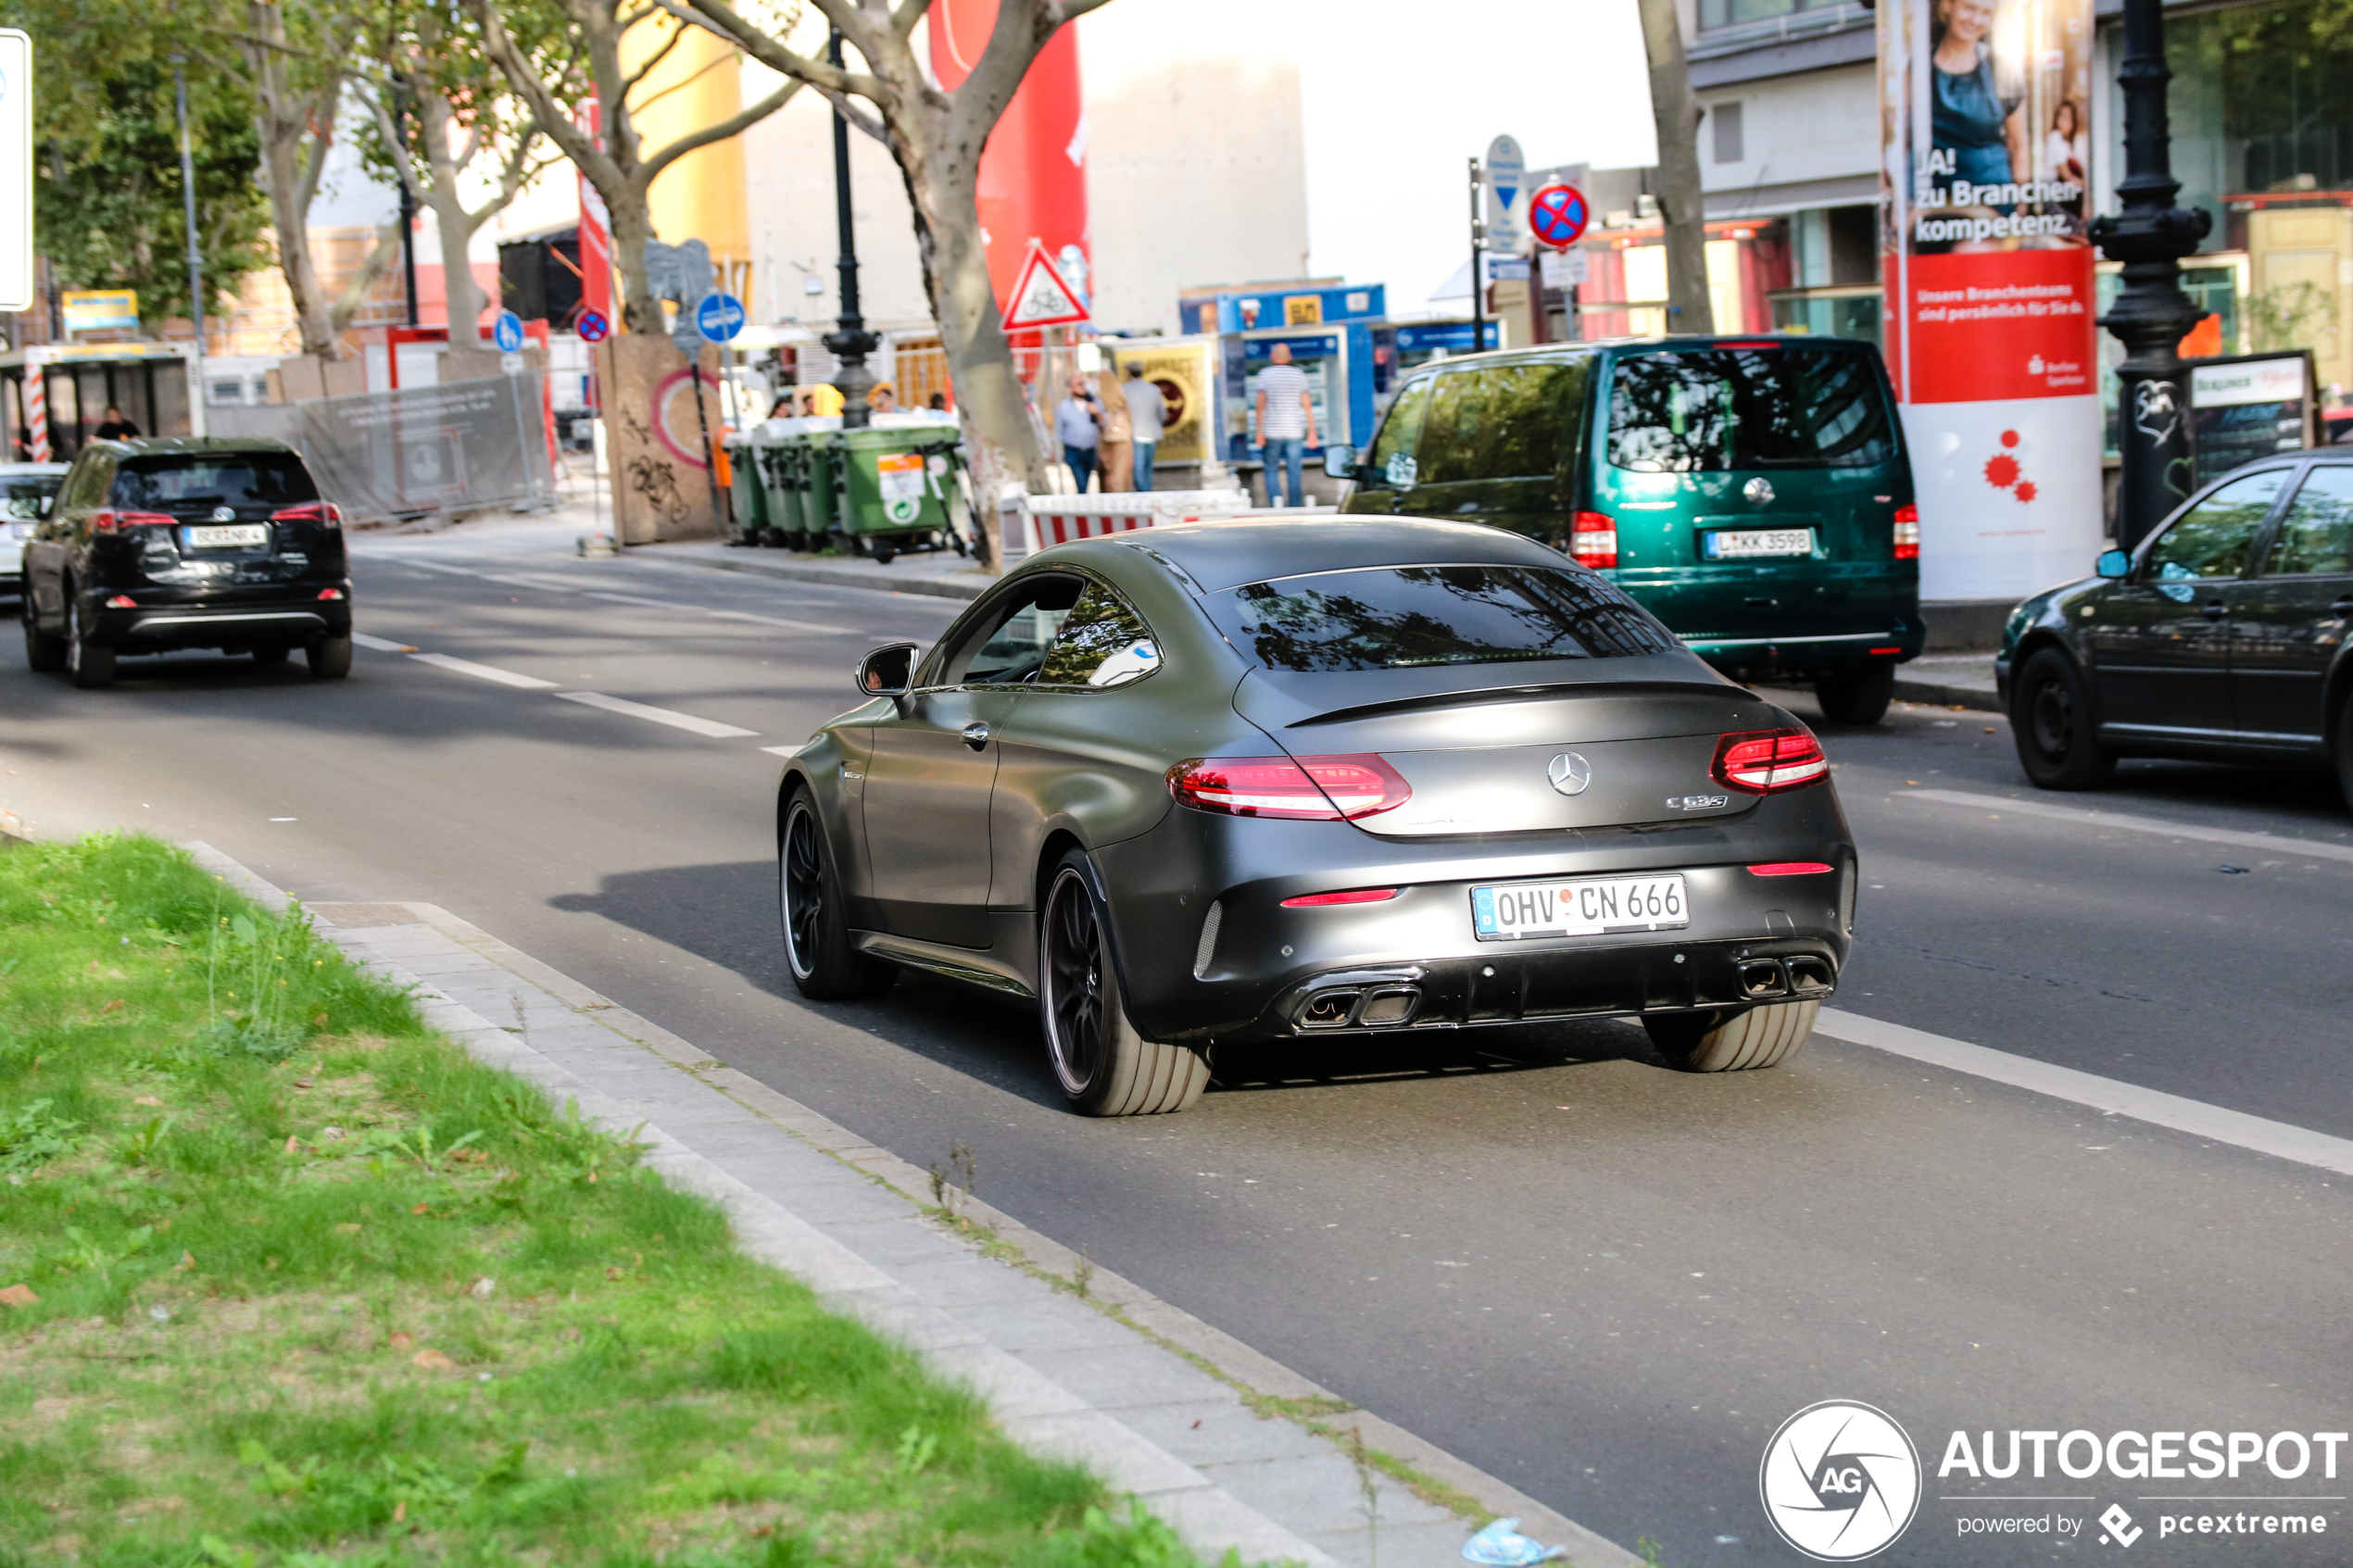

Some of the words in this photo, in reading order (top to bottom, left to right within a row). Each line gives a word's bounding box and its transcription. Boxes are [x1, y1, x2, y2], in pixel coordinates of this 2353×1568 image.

[1916, 187, 1946, 208] zu
[1952, 180, 2082, 207] Branchen-
[1915, 209, 2071, 245] kompetenz.
[1917, 289, 1965, 303] Unsere
[1967, 283, 2073, 301] Branchenteams
[1918, 306, 1946, 321] sind
[1947, 302, 2026, 322] persönlich
[2027, 301, 2048, 316] für
[2049, 300, 2069, 315] Sie
[1718, 535, 1730, 551] L
[1742, 533, 1763, 550] KK
[1767, 532, 1807, 549] 3598
[1498, 889, 1554, 926] OHV
[1579, 885, 1618, 921] CN
[1628, 883, 1681, 918] 666
